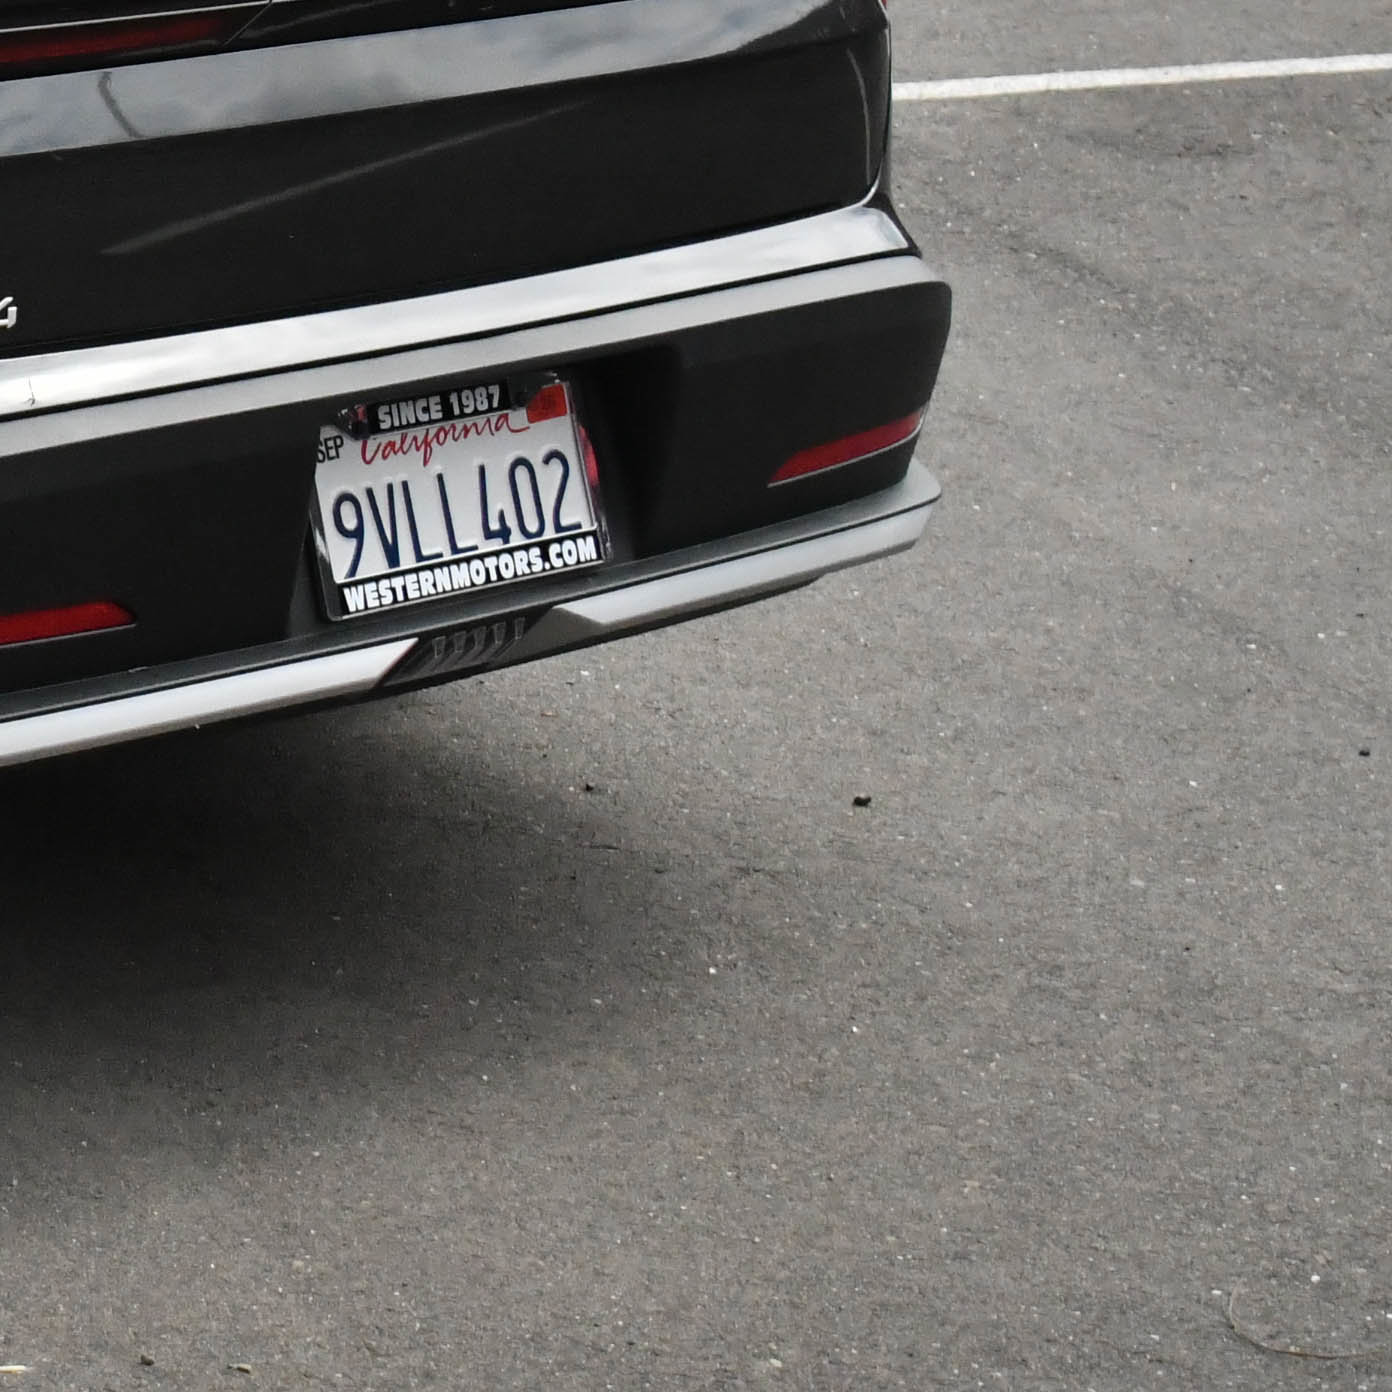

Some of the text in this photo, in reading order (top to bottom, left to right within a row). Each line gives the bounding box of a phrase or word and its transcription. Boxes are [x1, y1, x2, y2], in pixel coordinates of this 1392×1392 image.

[360, 411, 531, 466] California
[377, 384, 501, 430] SINCE 1987
[332, 448, 583, 580] 9VLL402
[342, 536, 598, 615] WESTERNMOTORS.COM
